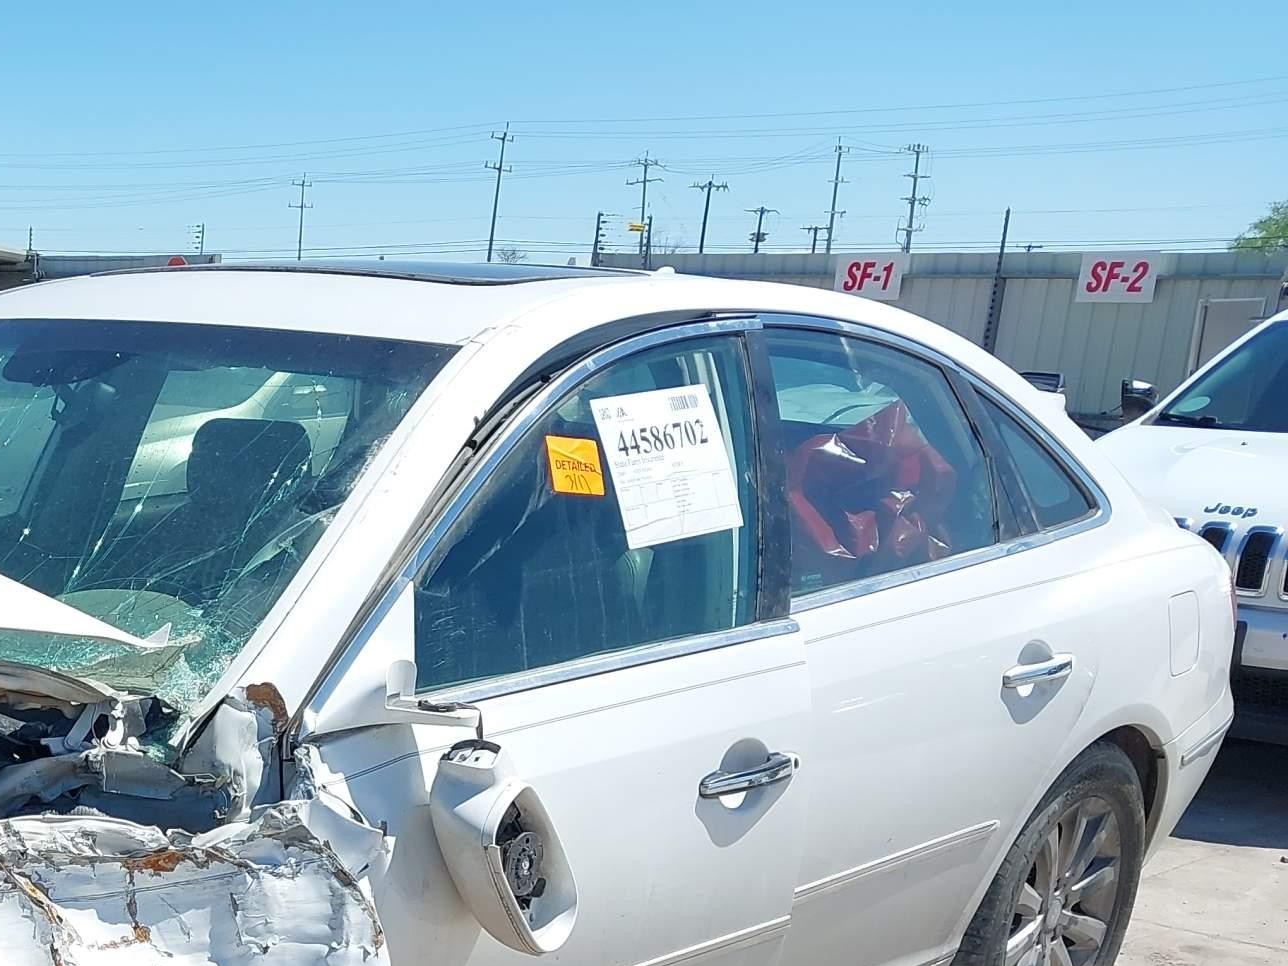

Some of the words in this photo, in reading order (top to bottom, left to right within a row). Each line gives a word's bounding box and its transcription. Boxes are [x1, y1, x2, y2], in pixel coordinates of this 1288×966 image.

[843, 261, 894, 291] SF-1
[1085, 261, 1149, 292] SF-2
[617, 418, 709, 457] 44586702
[555, 459, 597, 473] DETAILED
[1203, 502, 1258, 519] Jeep
